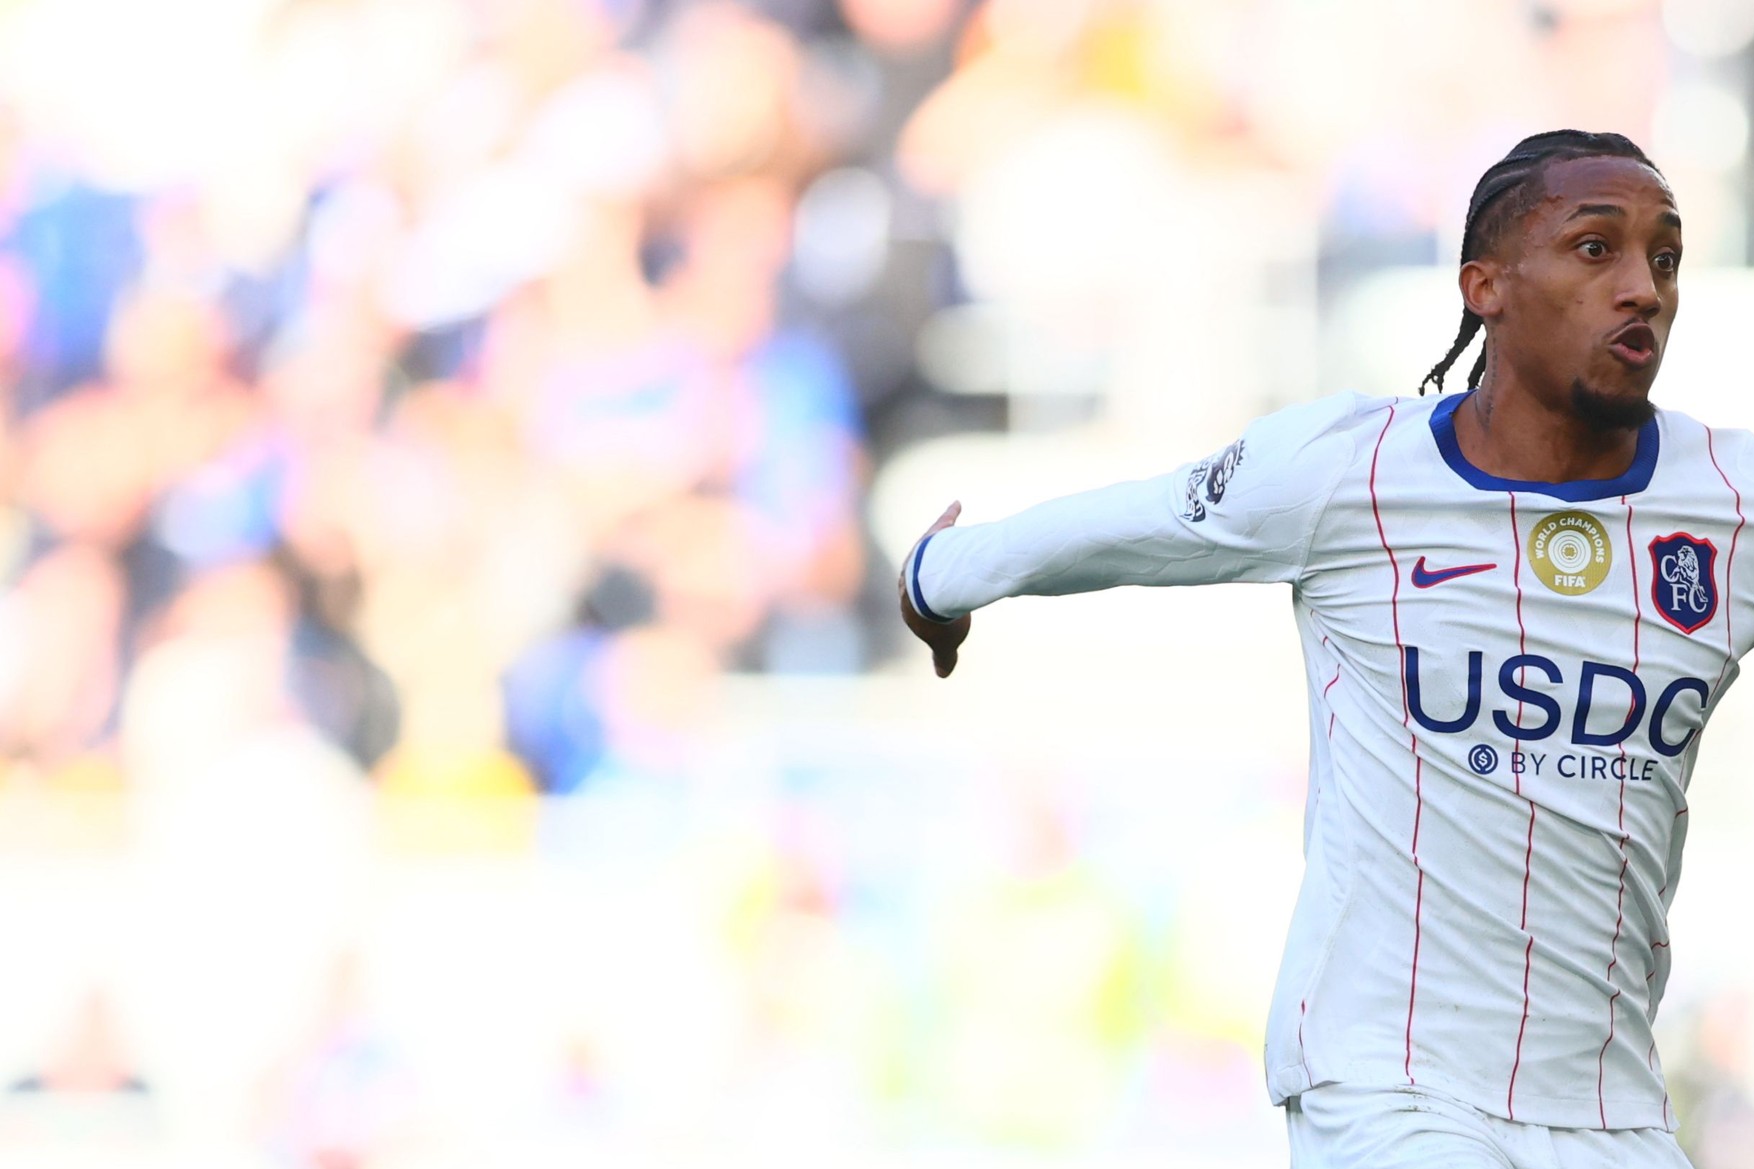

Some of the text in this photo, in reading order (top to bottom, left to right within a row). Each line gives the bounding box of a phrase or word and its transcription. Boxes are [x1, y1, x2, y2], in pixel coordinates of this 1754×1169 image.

[1535, 517, 1605, 563] WORLD CHAMPIONS
[1554, 574, 1586, 588] FIFA
[1404, 646, 1709, 757] USDC
[1511, 751, 1658, 781] BY CIRCLE
